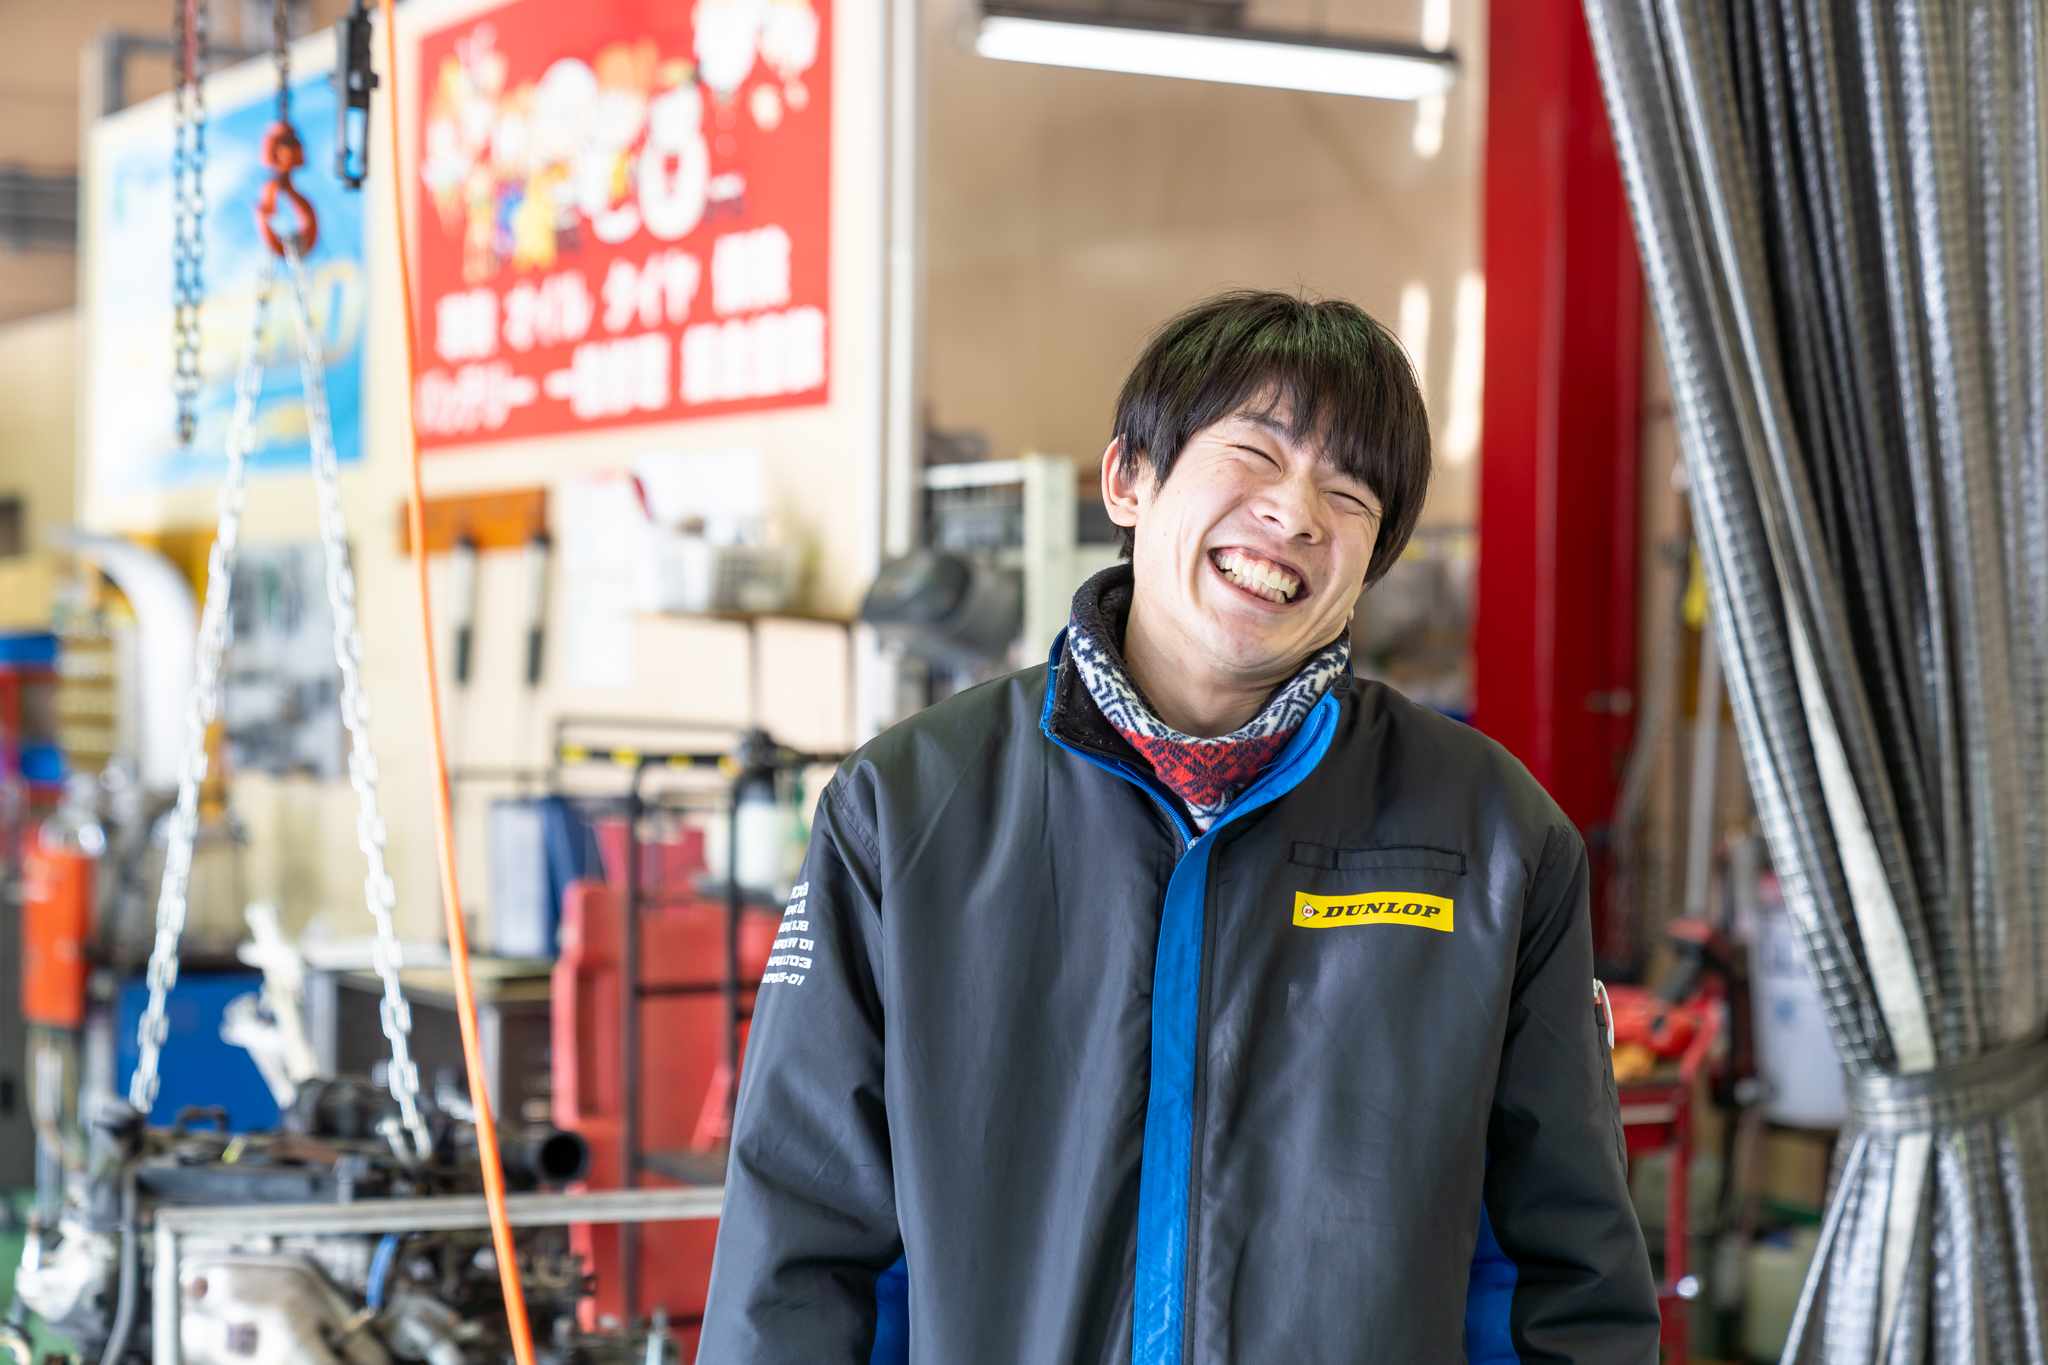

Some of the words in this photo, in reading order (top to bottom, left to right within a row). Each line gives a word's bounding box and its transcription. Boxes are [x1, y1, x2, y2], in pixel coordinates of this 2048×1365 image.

[605, 251, 699, 331] タイヤ
[1322, 902, 1441, 918] DUNLOP
